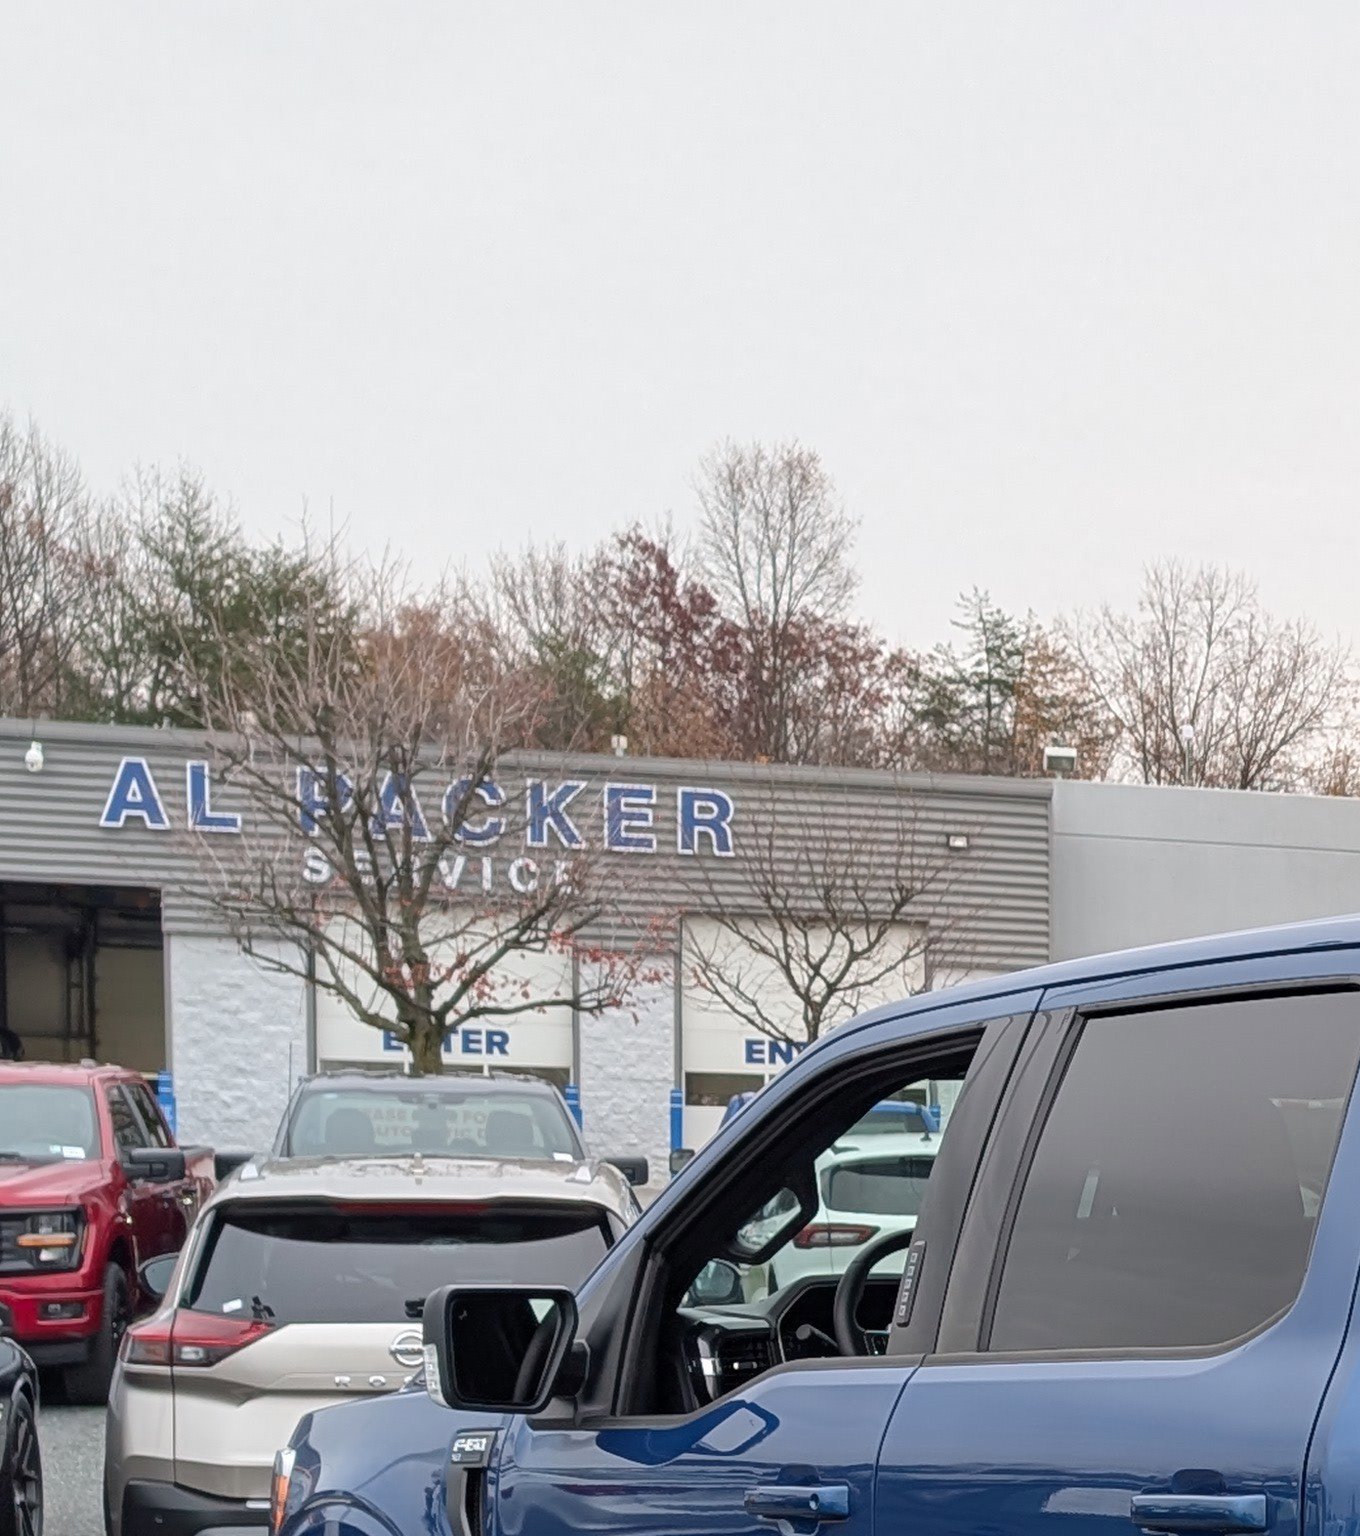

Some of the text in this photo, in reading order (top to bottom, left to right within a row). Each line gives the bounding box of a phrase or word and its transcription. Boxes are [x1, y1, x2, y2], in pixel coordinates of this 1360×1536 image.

[100, 756, 736, 857] AL PACKER
[383, 1027, 510, 1055] ETER
